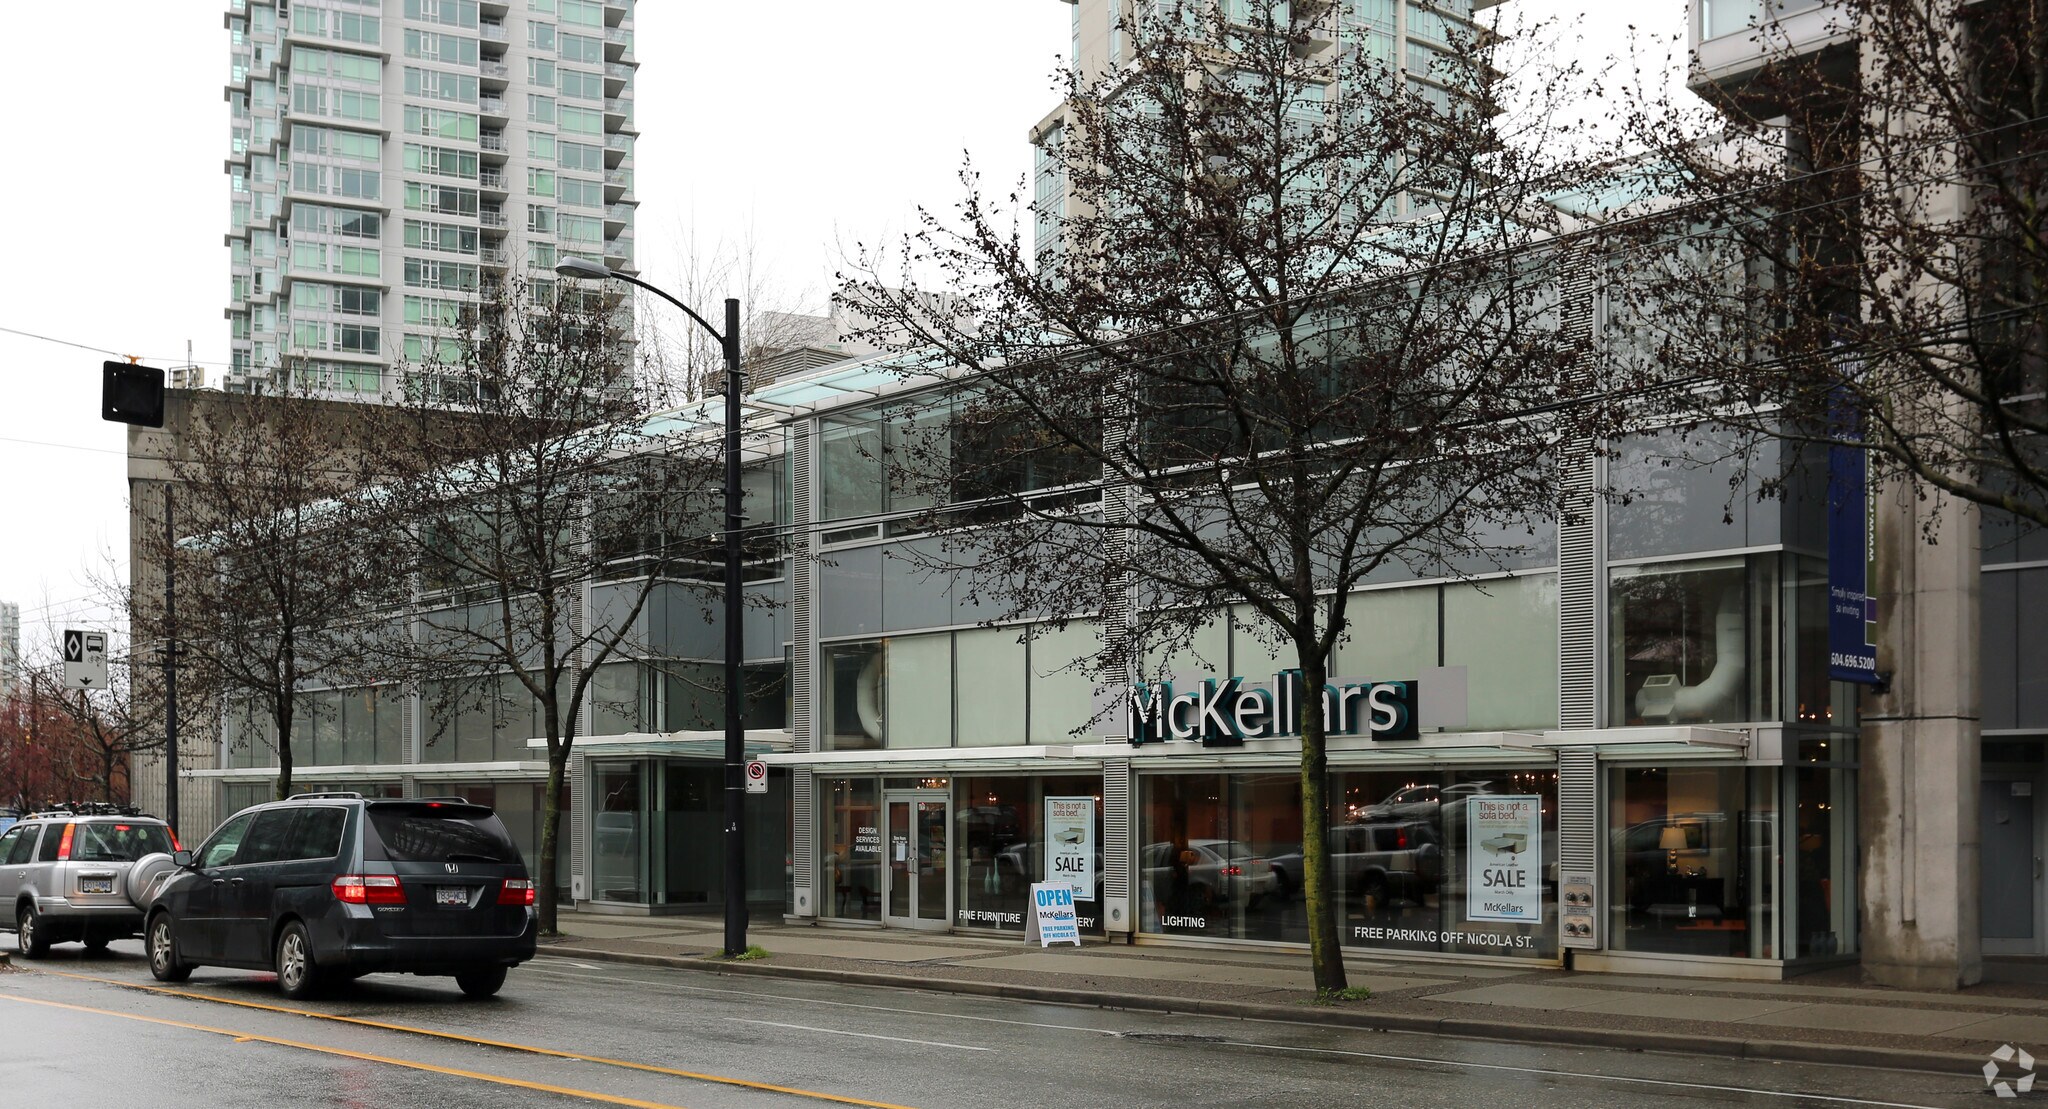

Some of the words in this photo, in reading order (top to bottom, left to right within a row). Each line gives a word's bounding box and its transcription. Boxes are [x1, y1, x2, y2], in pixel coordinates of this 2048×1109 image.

[1831, 586, 1846, 600] Simply
[1846, 589, 1865, 602] inspired
[1842, 603, 1860, 618] inviting
[1831, 652, 1875, 670] 604.696.5200
[1053, 801, 1064, 810] This
[1066, 801, 1070, 810] is
[1071, 802, 1082, 810] not
[1478, 801, 1496, 810] This
[1498, 801, 1504, 810] is
[1506, 802, 1520, 810] not
[1479, 811, 1496, 820] sofa
[856, 836, 880, 844] SERVICES
[1055, 856, 1084, 872] SALE
[1483, 868, 1526, 888] SALE
[1036, 889, 1072, 906] OPEN
[1484, 902, 1524, 912] McKellars
[958, 910, 976, 920] FINE
[977, 911, 1020, 922] FURNITURE
[1040, 910, 1074, 918] McKellars
[1161, 916, 1206, 928] LIGHTING
[1354, 926, 1384, 939] FREE
[1386, 928, 1437, 942] PARKING
[1440, 931, 1464, 944] OFF
[1515, 936, 1534, 948] ST.
